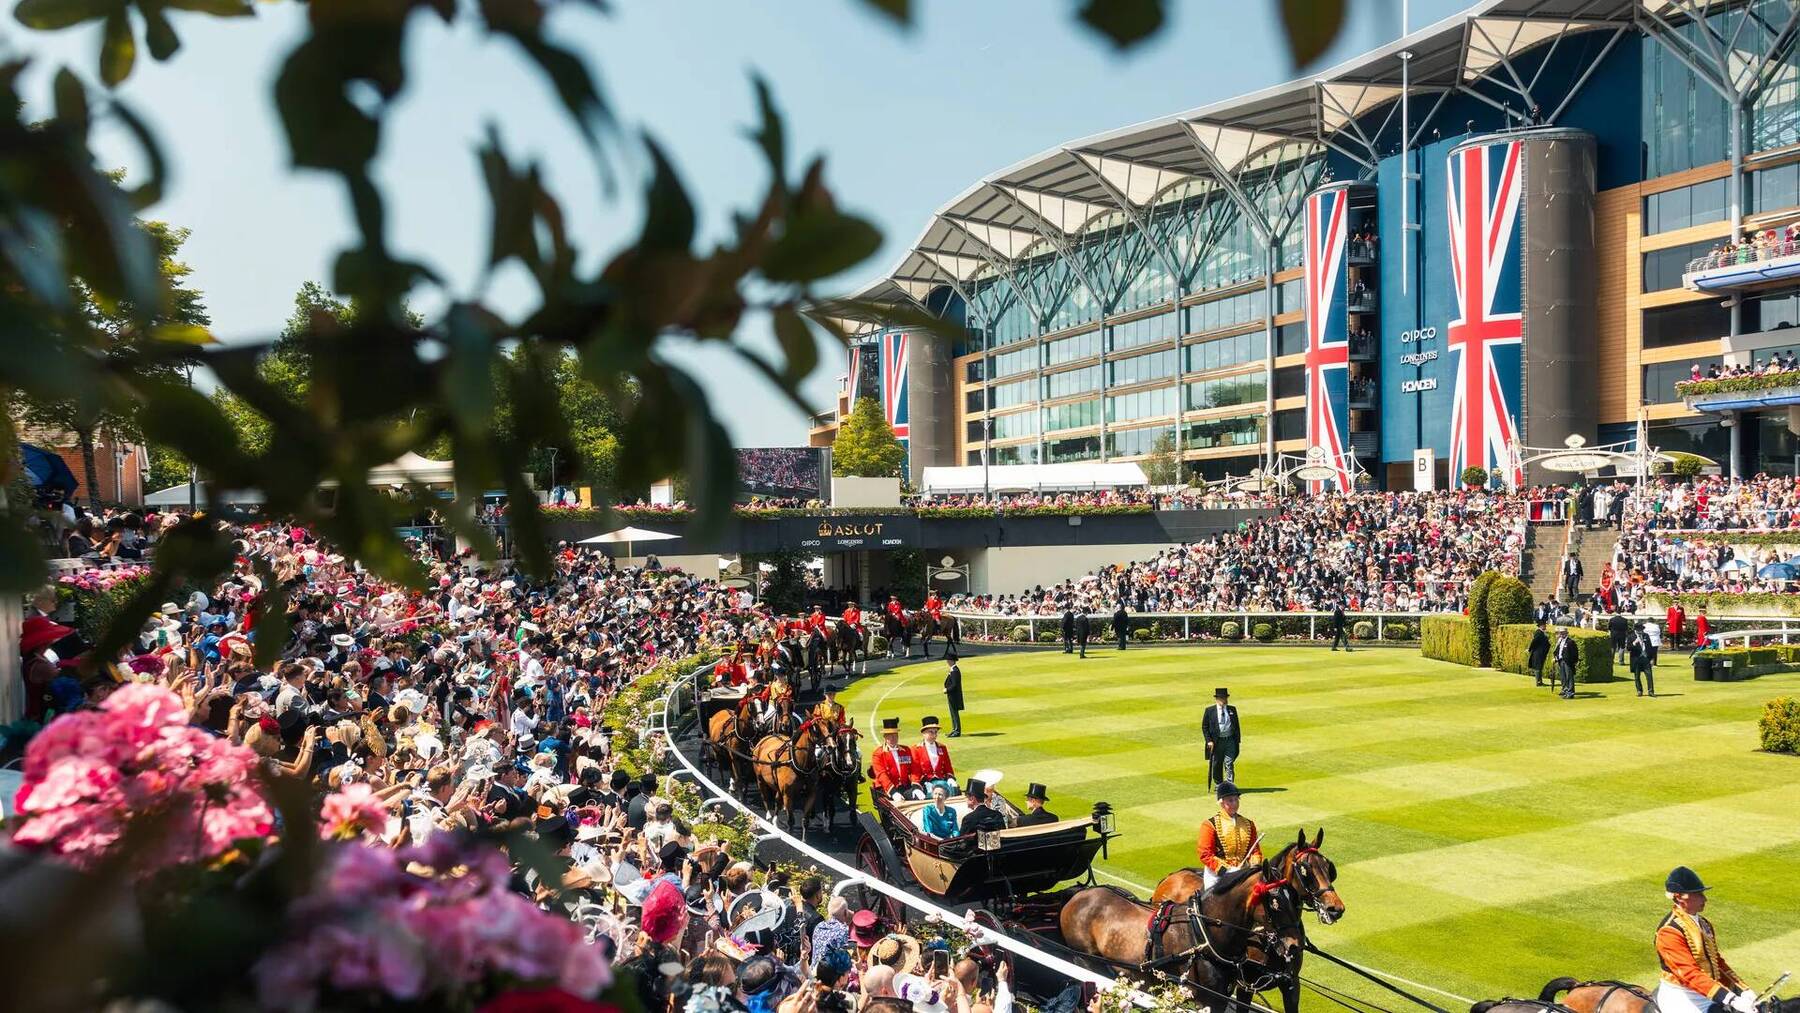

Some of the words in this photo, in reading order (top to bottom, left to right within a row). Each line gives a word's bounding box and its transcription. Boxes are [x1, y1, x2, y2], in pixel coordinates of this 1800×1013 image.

[1401, 327, 1436, 343] QIPCO
[1418, 457, 1427, 472] B
[834, 523, 884, 536] ASCOT
[801, 539, 821, 547] QIPCO
